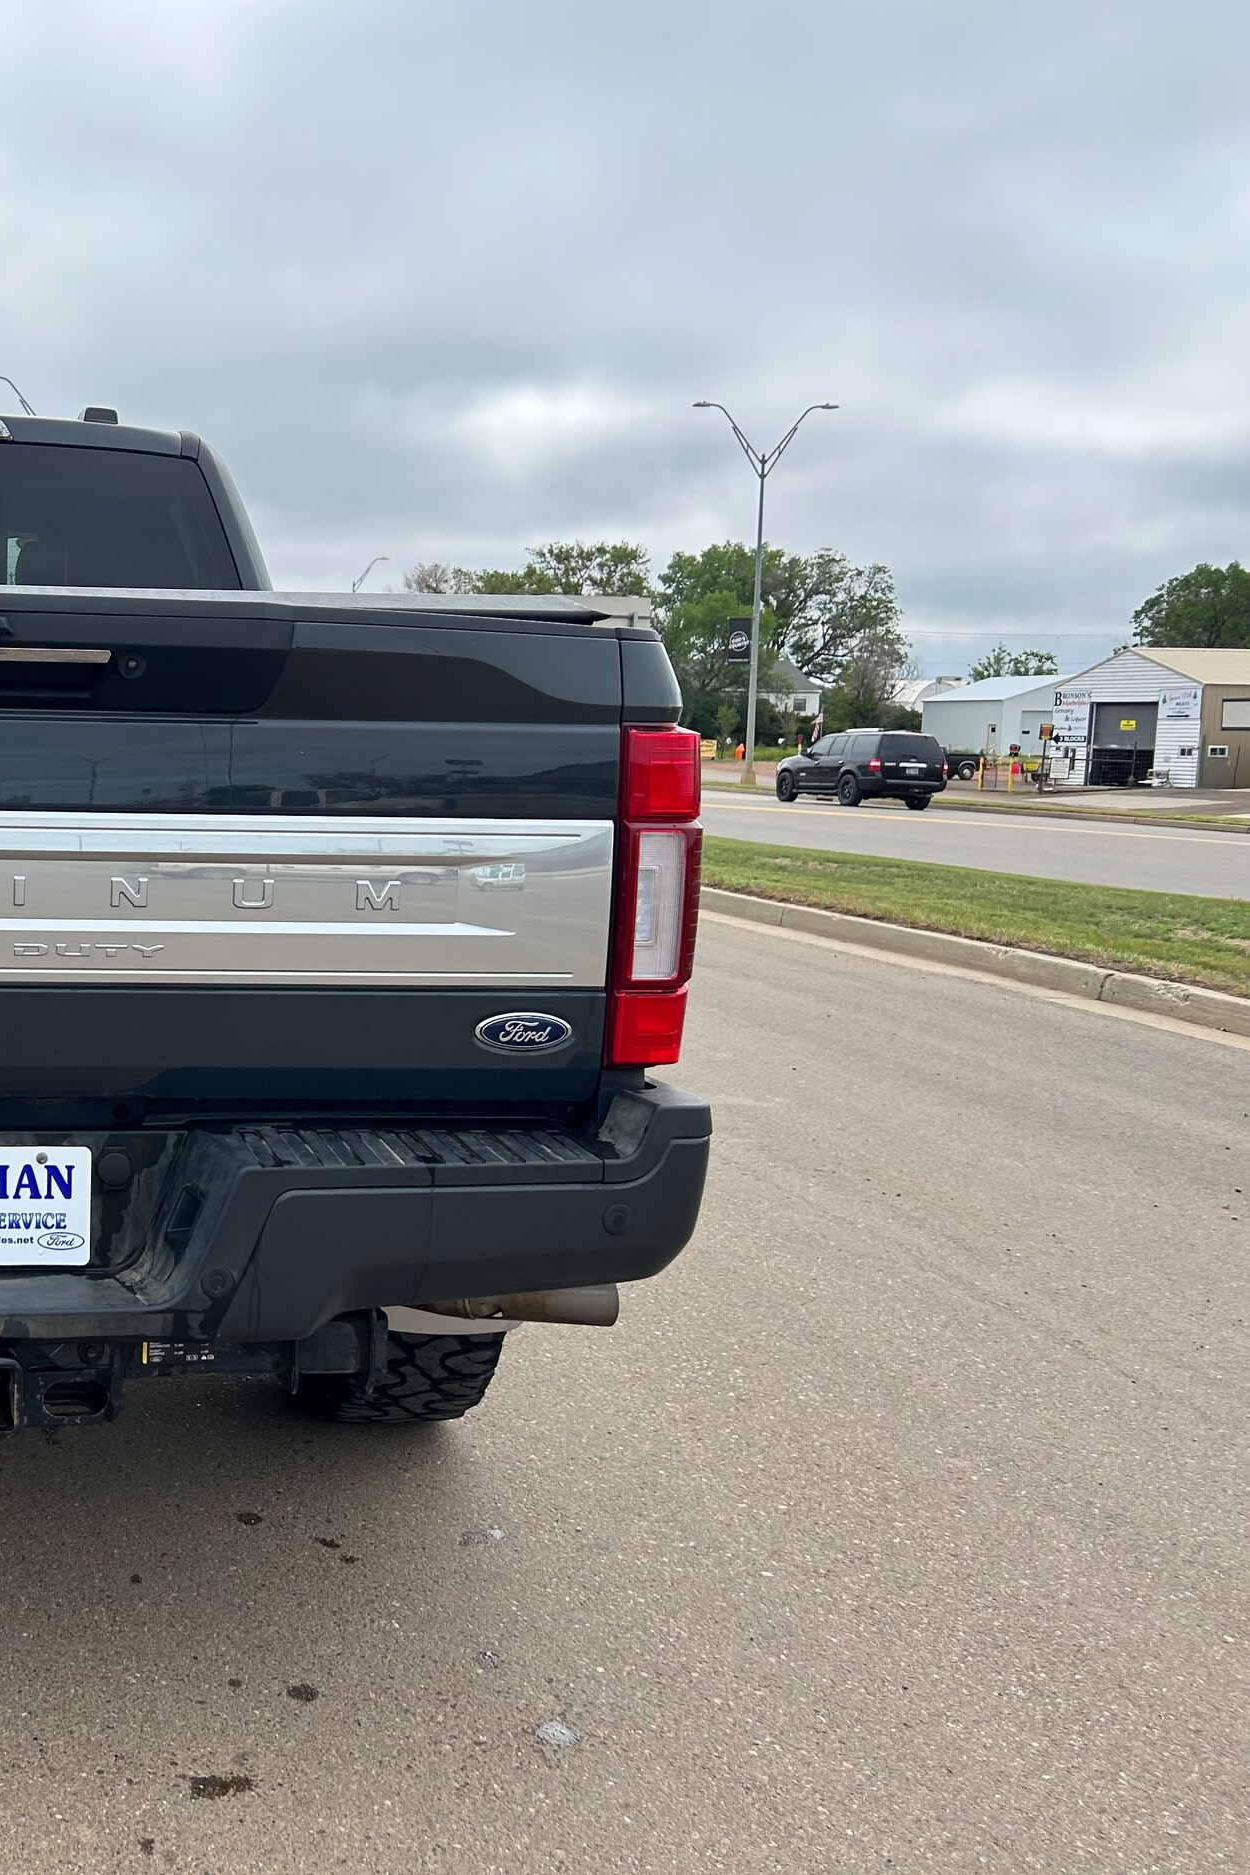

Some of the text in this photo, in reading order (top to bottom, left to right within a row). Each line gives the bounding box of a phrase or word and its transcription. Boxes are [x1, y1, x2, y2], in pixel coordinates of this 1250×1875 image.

[1054, 707, 1075, 715] Grocery
[13, 943, 165, 958] DUTY
[499, 1020, 552, 1042] Ford
[46, 1235, 75, 1248] Ford
